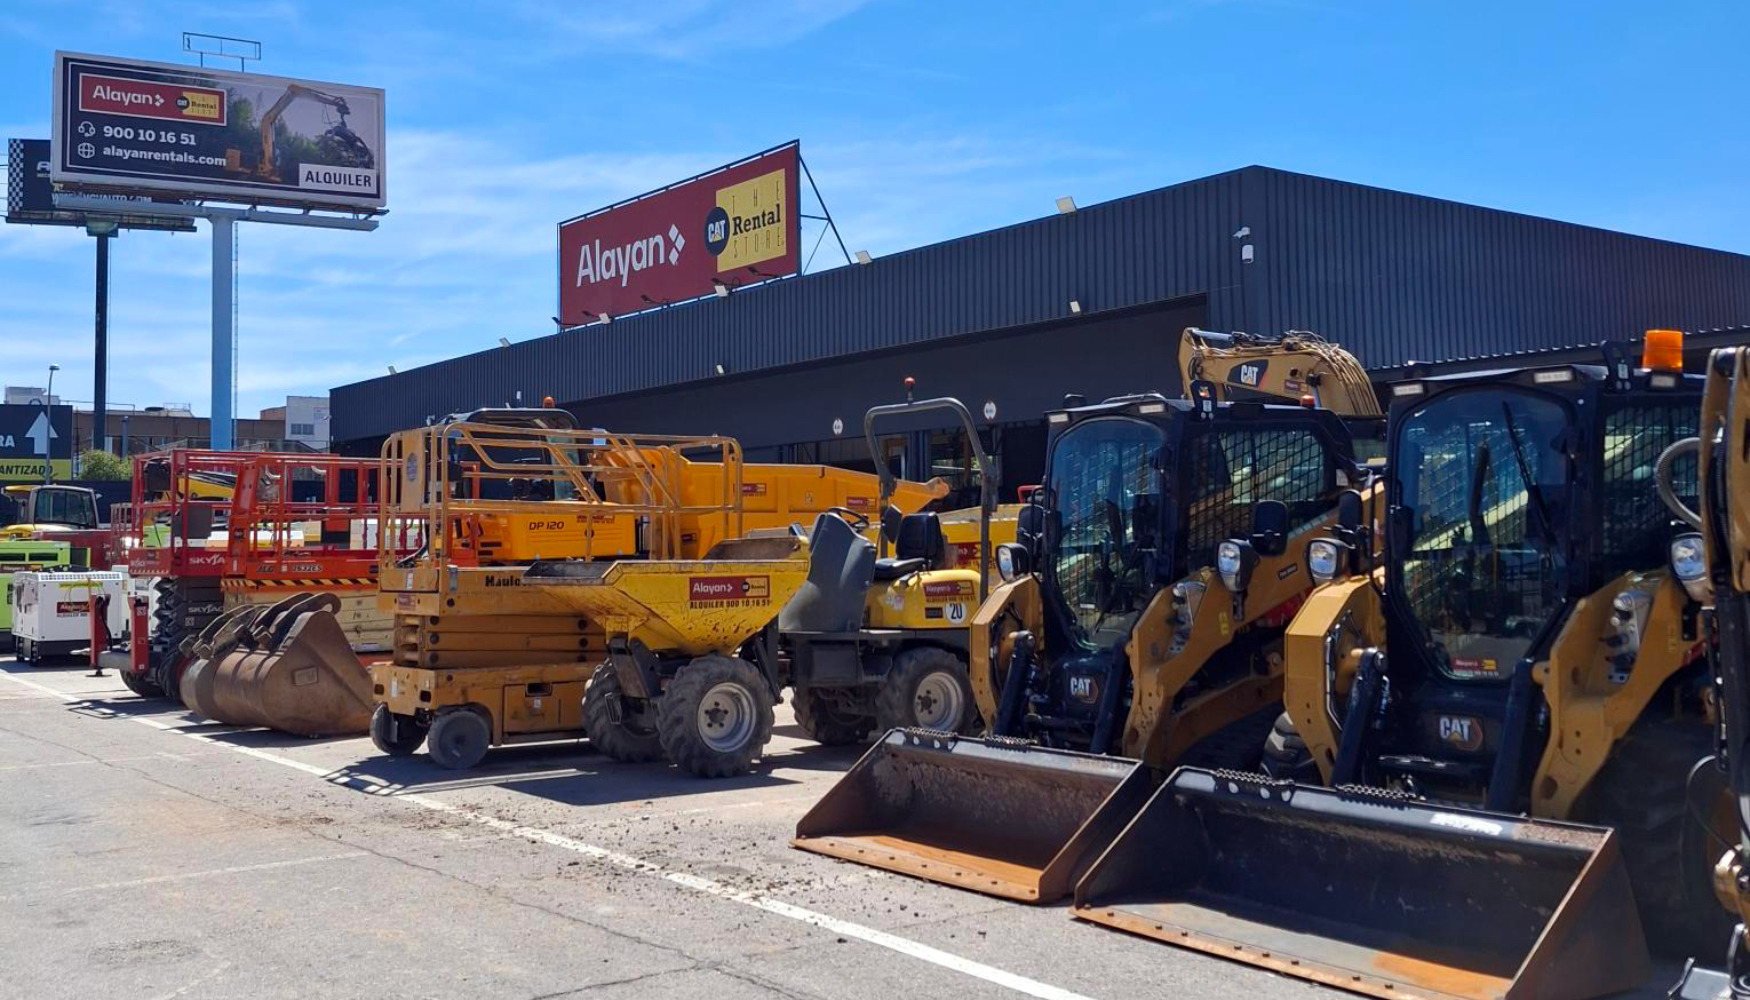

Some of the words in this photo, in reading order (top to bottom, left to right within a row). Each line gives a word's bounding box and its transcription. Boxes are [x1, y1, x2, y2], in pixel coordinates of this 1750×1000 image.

[93, 85, 153, 106] Alayan
[191, 101, 217, 110] Rental
[103, 125, 135, 140] 900
[138, 129, 156, 142] 10
[159, 132, 177, 144] 16
[180, 133, 197, 146] 51
[102, 145, 227, 167] alayanrentals.com
[305, 170, 371, 188] ALQUILER
[707, 220, 726, 243] CAT
[731, 203, 781, 237] Rental
[733, 226, 781, 259] STORE
[576, 232, 665, 288] Alayan
[1241, 364, 1259, 386] CAT
[529, 522, 544, 531] DP
[546, 521, 564, 530] 120
[693, 582, 727, 595] Alayan
[690, 601, 724, 610] ALQUILER
[726, 600, 740, 608] 900
[950, 602, 963, 619] 20
[1070, 676, 1091, 697] CAT
[1440, 716, 1471, 742] CAT
